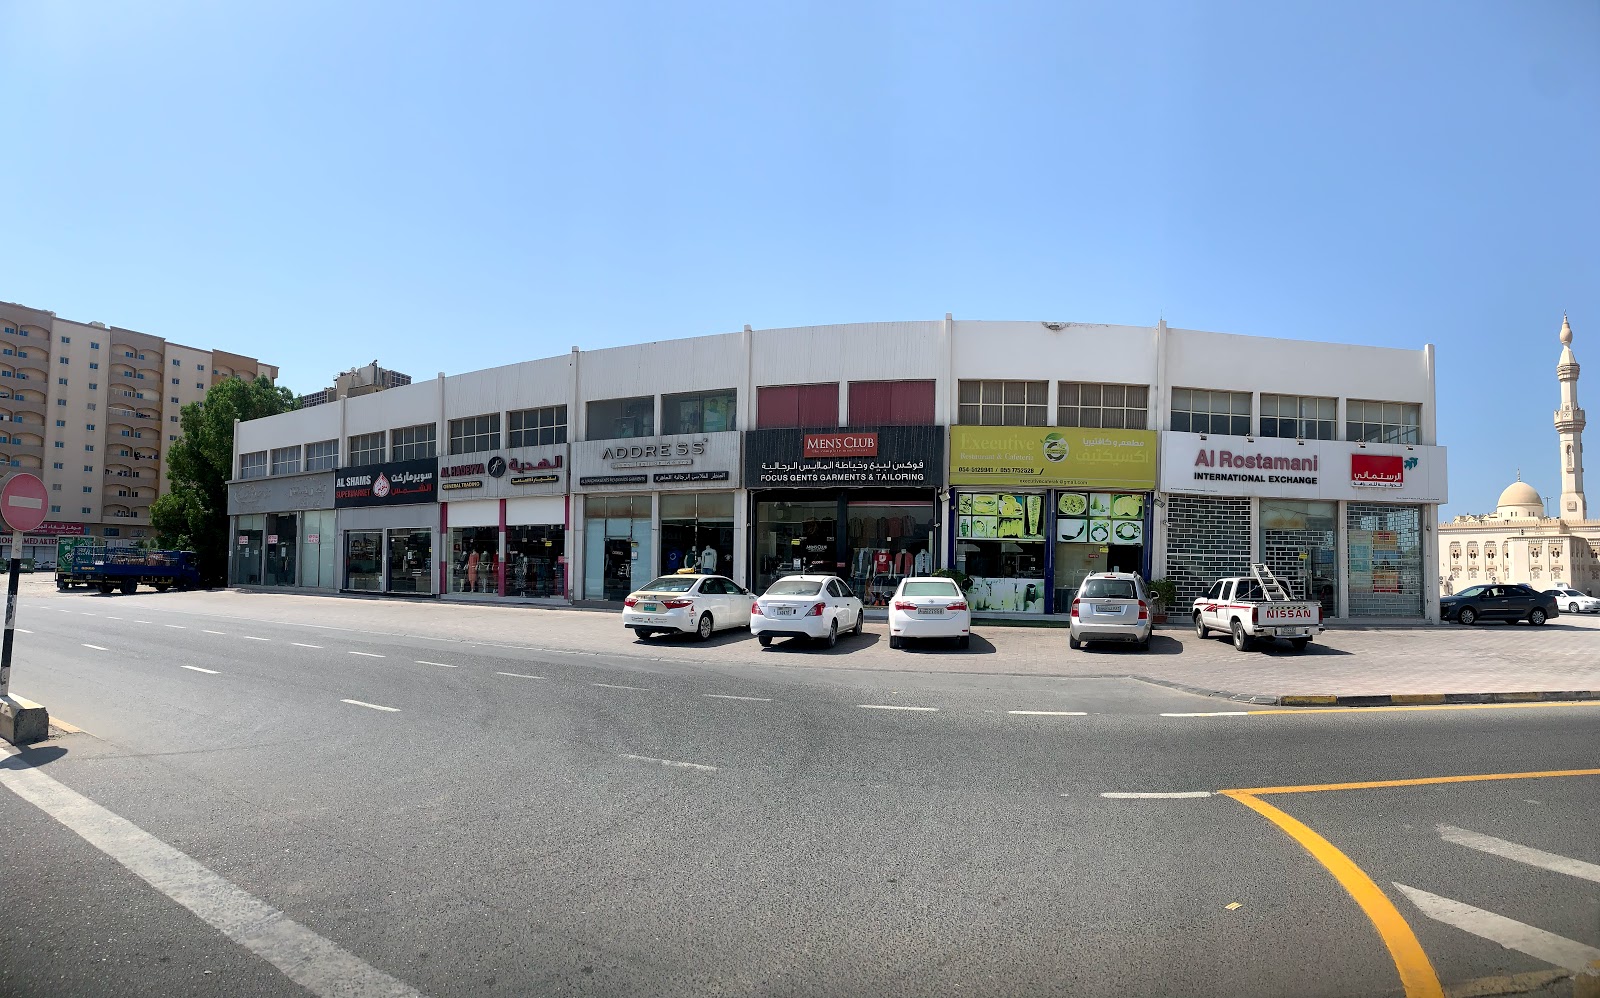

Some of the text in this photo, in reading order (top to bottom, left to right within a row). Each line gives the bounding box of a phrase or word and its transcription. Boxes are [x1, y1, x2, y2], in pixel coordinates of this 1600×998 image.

[843, 436, 875, 448] CLUB
[960, 433, 1035, 450] Executive
[602, 441, 705, 460] ADDRESS
[798, 461, 834, 472] الملابس
[1194, 449, 1318, 472] Al Rostamani
[440, 466, 450, 478] AL
[761, 461, 798, 473] الرجالية
[336, 475, 371, 488] AL SHAMS
[390, 471, 433, 484] سوبرماركت
[760, 473, 924, 482] FOCUS GENTS GARMENTS & TAILORING
[1193, 472, 1318, 485] INTERNATIONAL EXCHANGE
[1354, 470, 1402, 482] الرستماني
[336, 488, 371, 499] SUPERMARKET
[390, 483, 432, 496] الشمس
[1266, 609, 1311, 619] NISSAN
